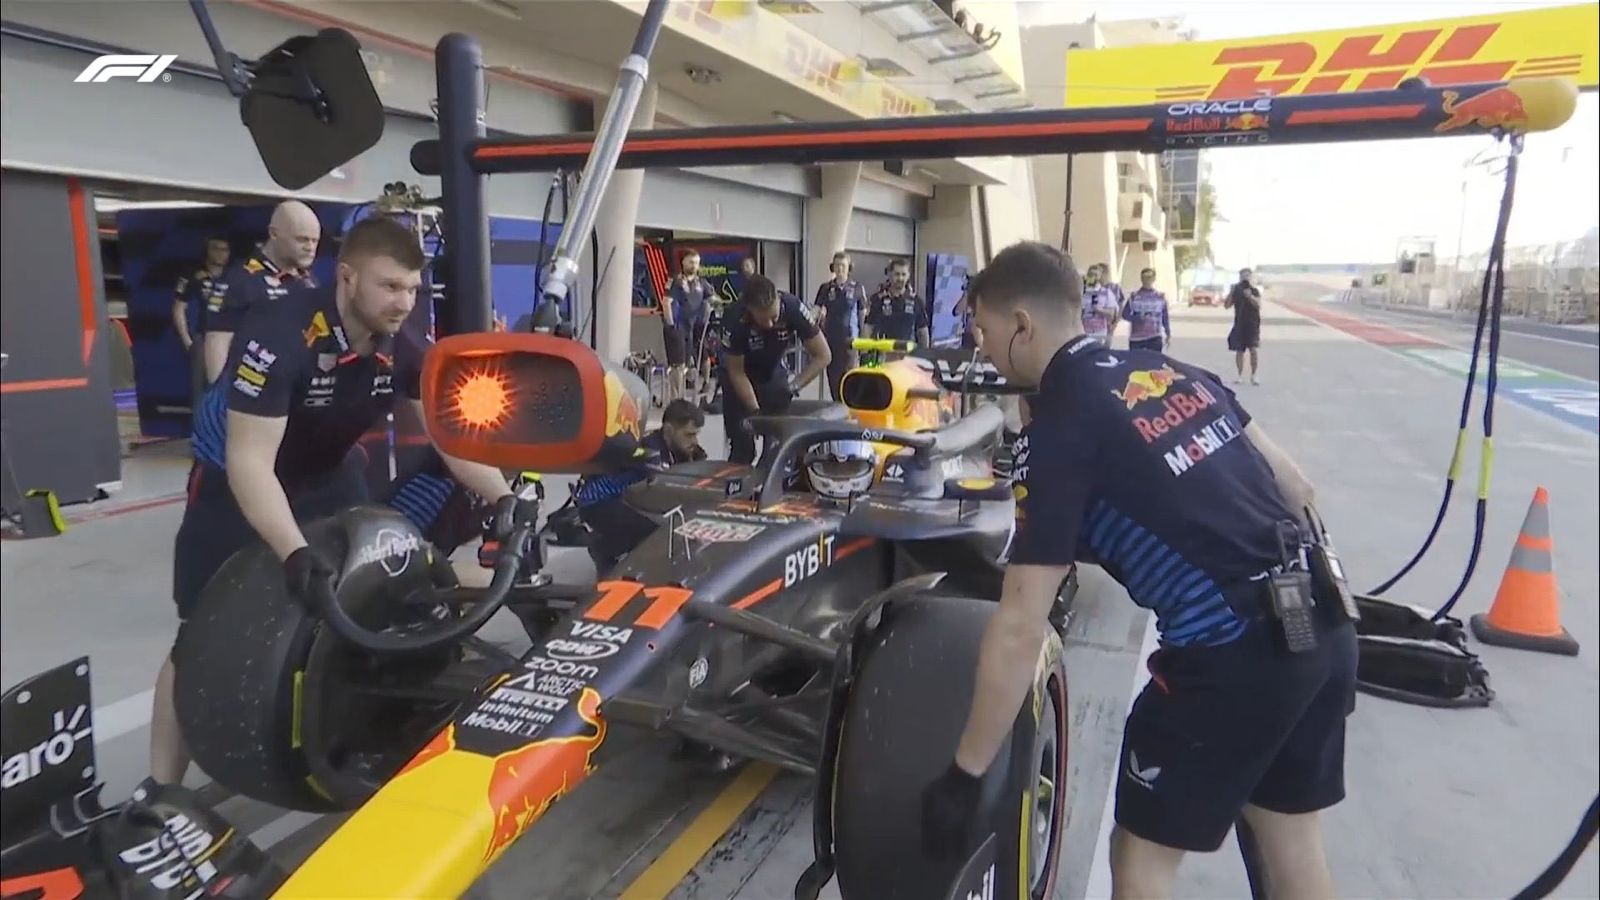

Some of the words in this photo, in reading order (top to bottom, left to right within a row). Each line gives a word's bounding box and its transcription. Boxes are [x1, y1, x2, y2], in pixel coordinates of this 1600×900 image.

[1207, 23, 1517, 100] DHL
[1167, 99, 1273, 115] ORACLE
[1164, 424, 1224, 477] Mobil
[784, 531, 835, 588] BYBIT
[583, 580, 694, 630] 11
[570, 620, 633, 644] VISA
[524, 657, 599, 679] zoom
[462, 712, 524, 734] Mobil
